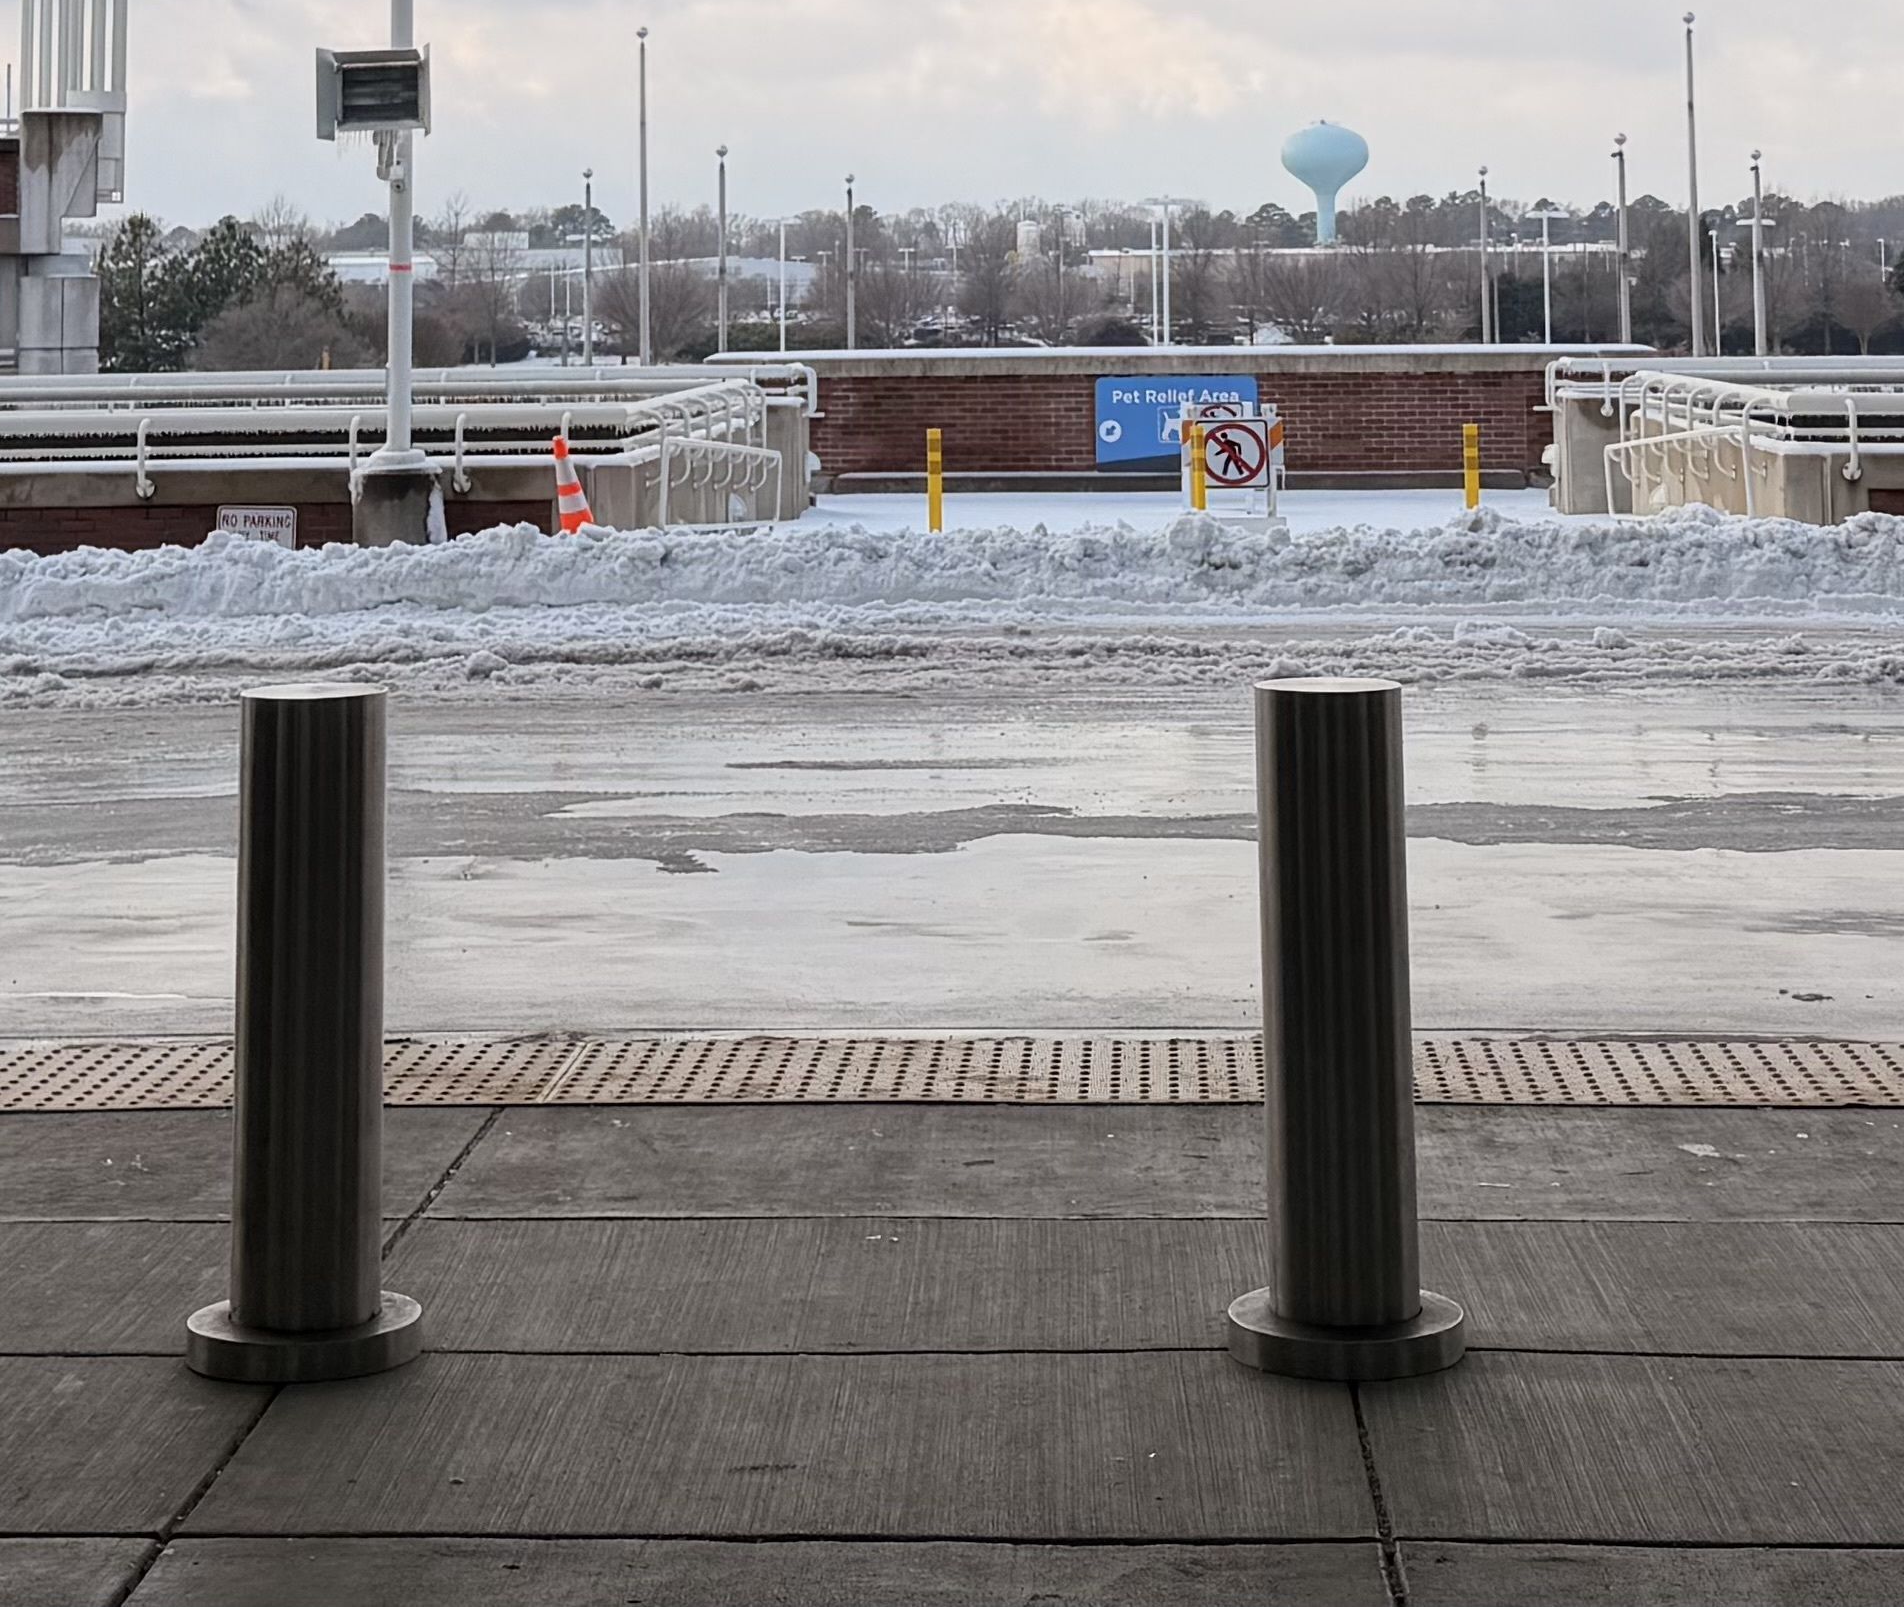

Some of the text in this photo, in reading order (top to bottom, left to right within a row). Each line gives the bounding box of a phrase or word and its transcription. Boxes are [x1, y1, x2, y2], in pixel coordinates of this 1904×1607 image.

[1112, 389, 1240, 404] Pet Relief Area
[222, 514, 291, 528] NO PARKING
